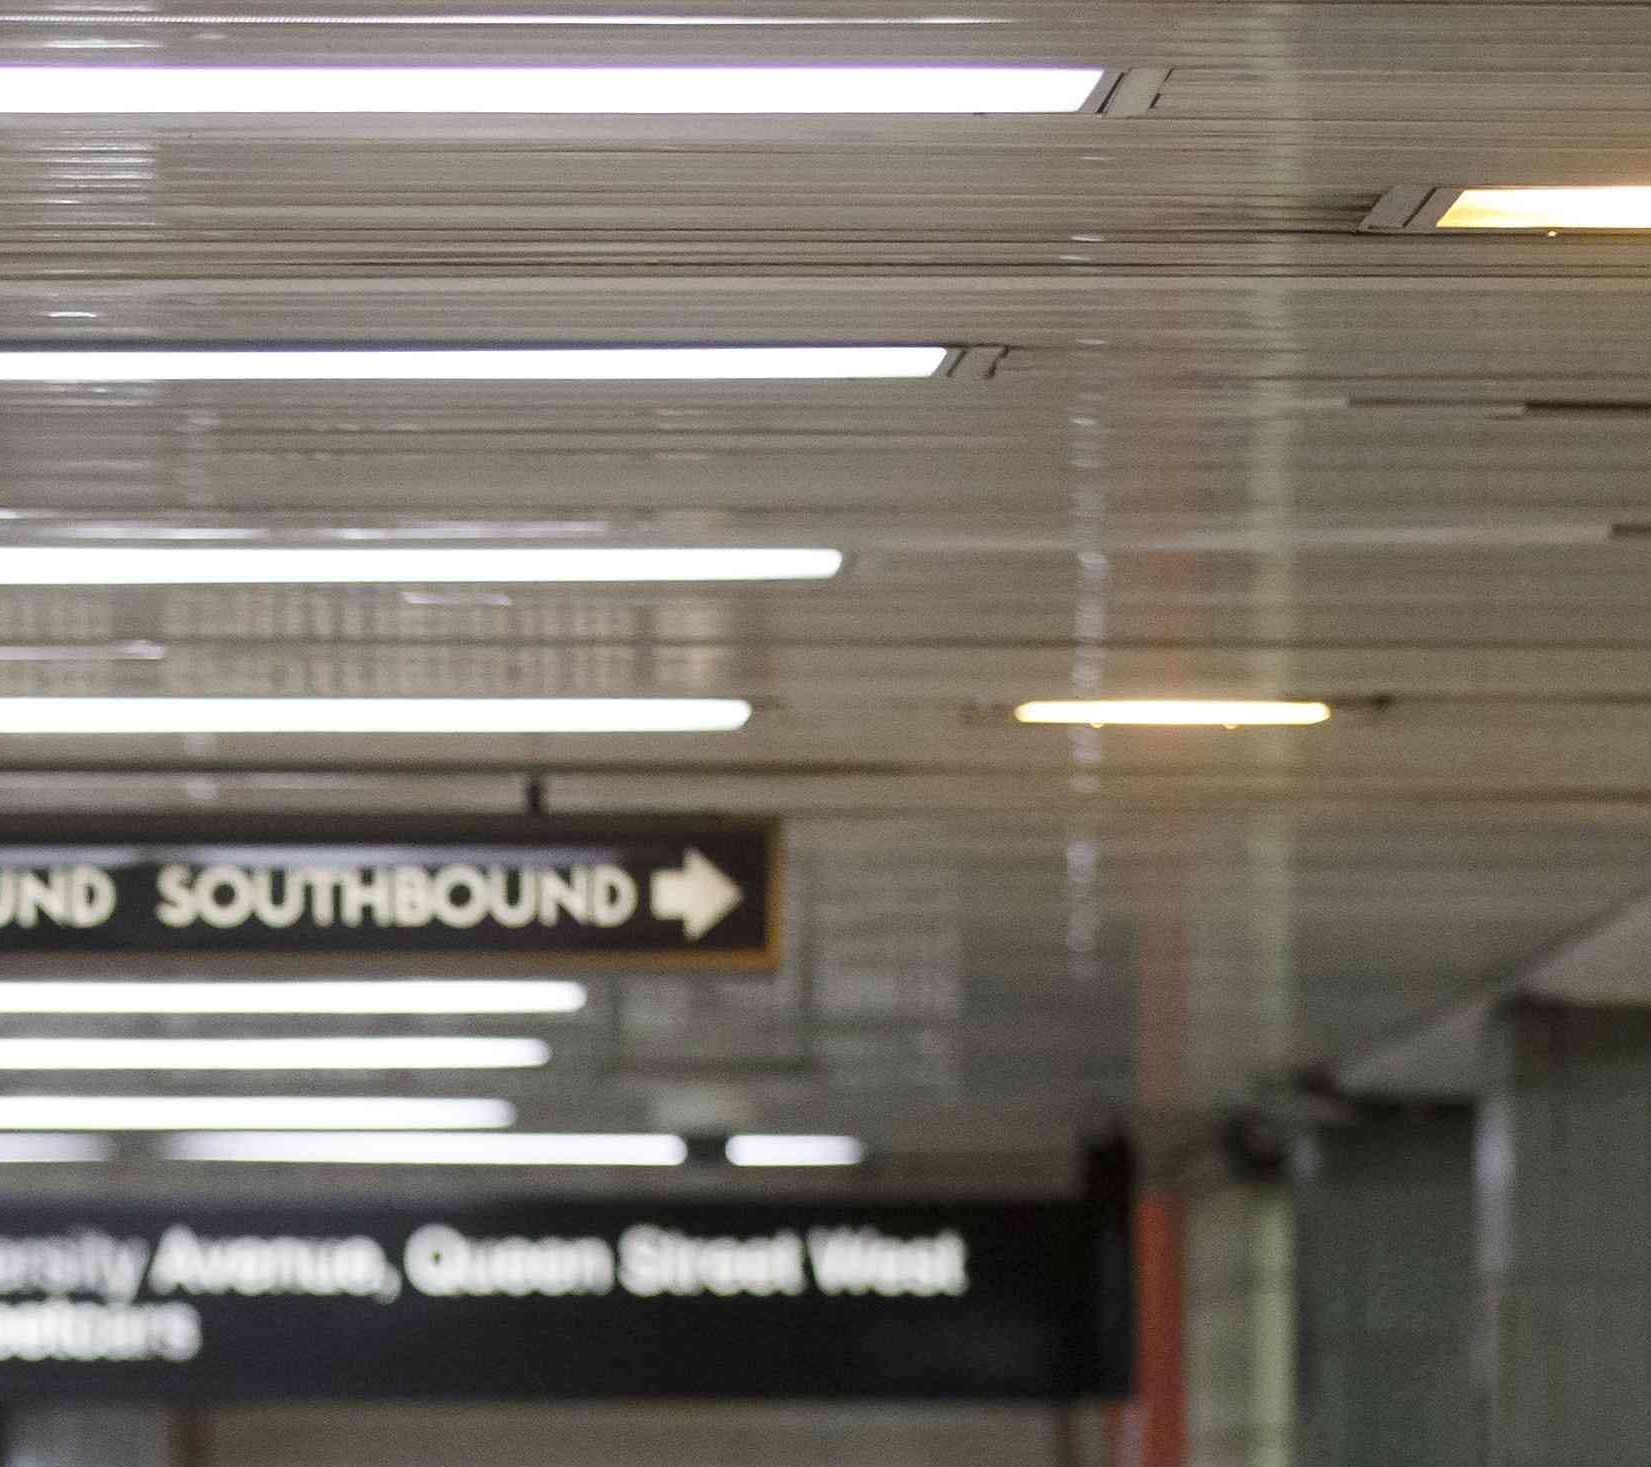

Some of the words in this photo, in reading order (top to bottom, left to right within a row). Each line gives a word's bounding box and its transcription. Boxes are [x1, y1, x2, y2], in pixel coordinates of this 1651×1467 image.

[155, 863, 639, 929] SOUTHBOUND
[149, 1223, 400, 1303] Avenue,
[404, 1223, 614, 1297] Queen
[617, 1223, 805, 1297] Street
[806, 1224, 969, 1297] West
